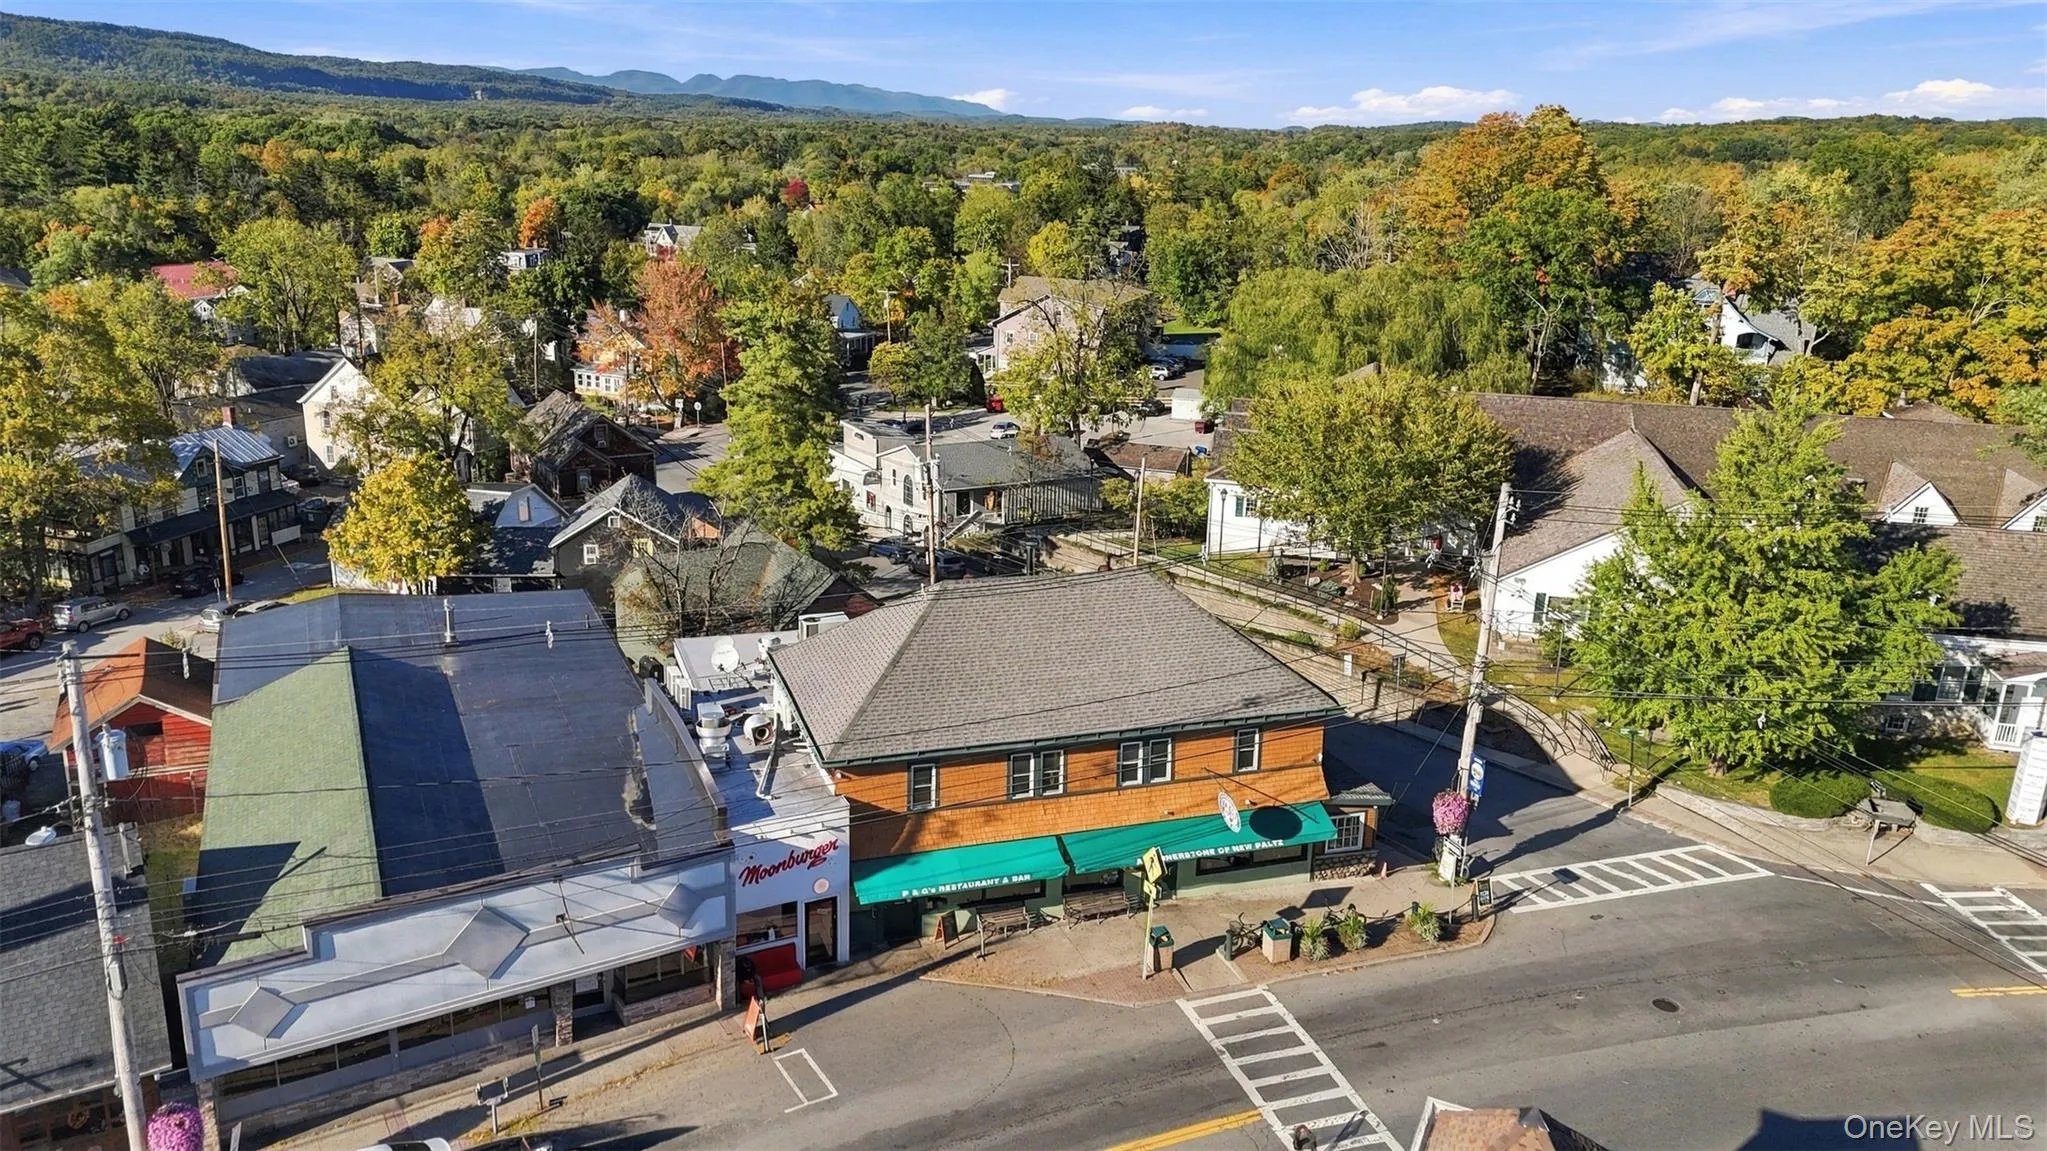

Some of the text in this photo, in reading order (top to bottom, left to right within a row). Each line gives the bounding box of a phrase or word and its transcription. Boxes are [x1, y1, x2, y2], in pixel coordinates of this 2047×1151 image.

[1217, 846, 1231, 855] OF
[1231, 843, 1253, 853] NEW
[1254, 839, 1284, 849] PALTZ
[739, 839, 839, 887] Moonburger
[938, 877, 1000, 892] RESTAURANT
[1011, 873, 1031, 884] BAR
